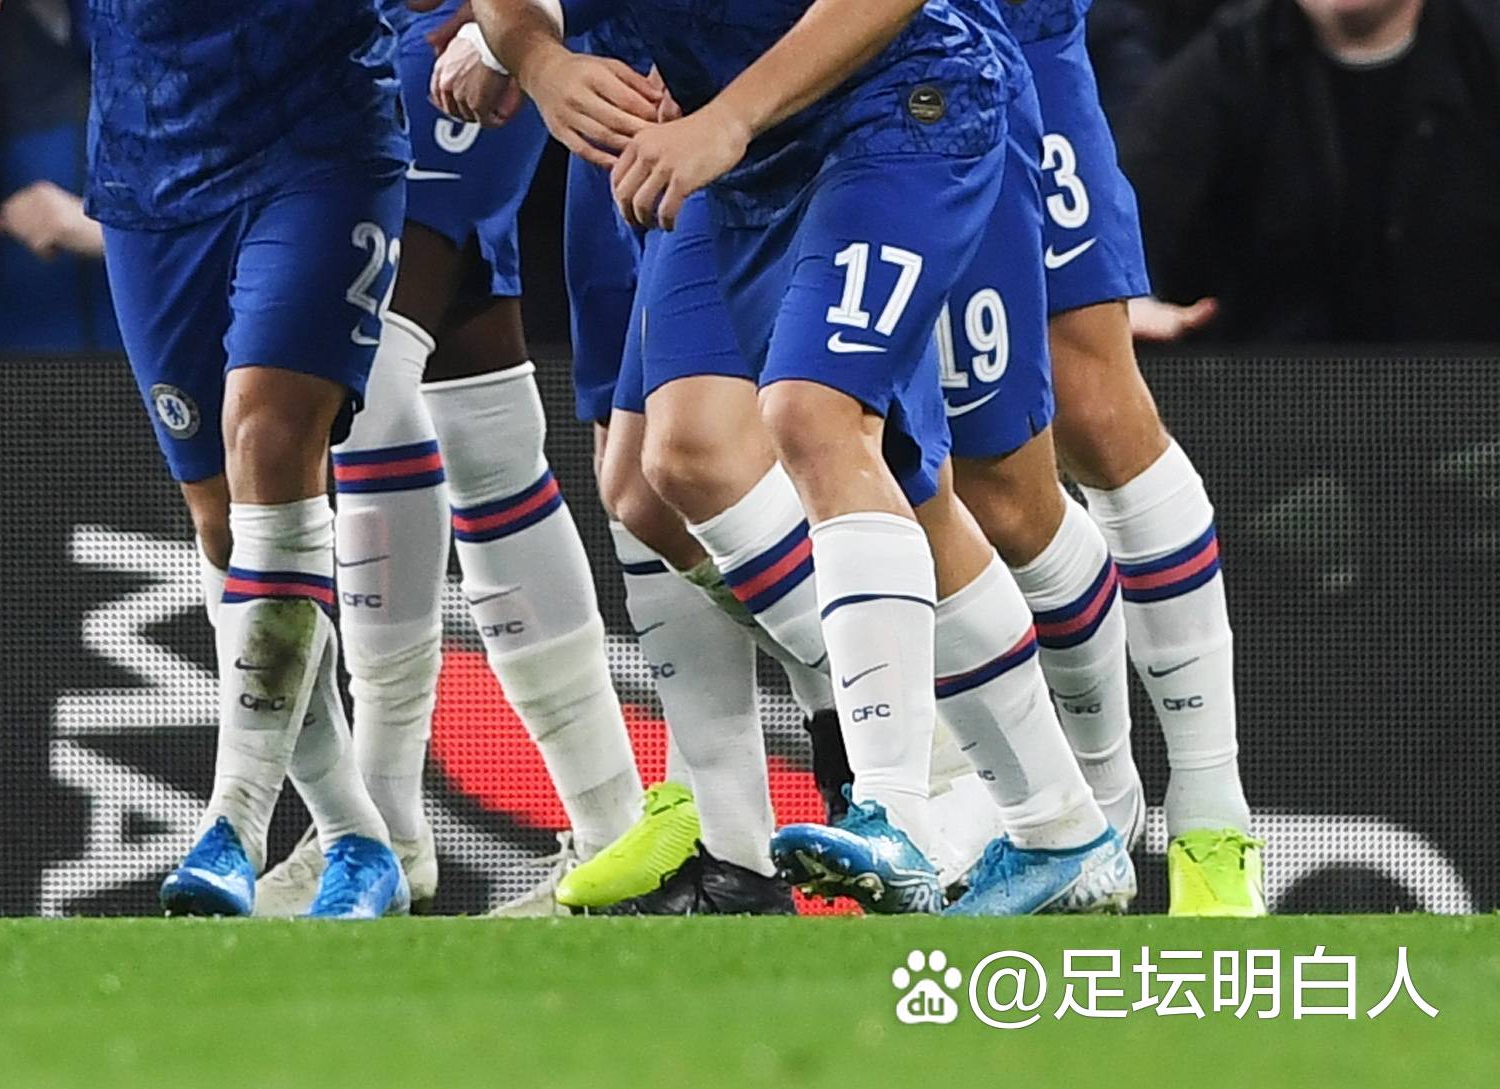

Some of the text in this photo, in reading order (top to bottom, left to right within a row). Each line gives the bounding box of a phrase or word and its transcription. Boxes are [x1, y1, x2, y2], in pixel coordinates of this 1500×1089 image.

[1041, 133, 1090, 229] 3
[826, 242, 923, 337] 17
[934, 288, 1009, 384] 19
[342, 592, 383, 609] CFC
[481, 620, 525, 638] CFC
[38, 523, 220, 917] MA
[852, 703, 891, 723] CFC
[1162, 695, 1204, 711] CFC
